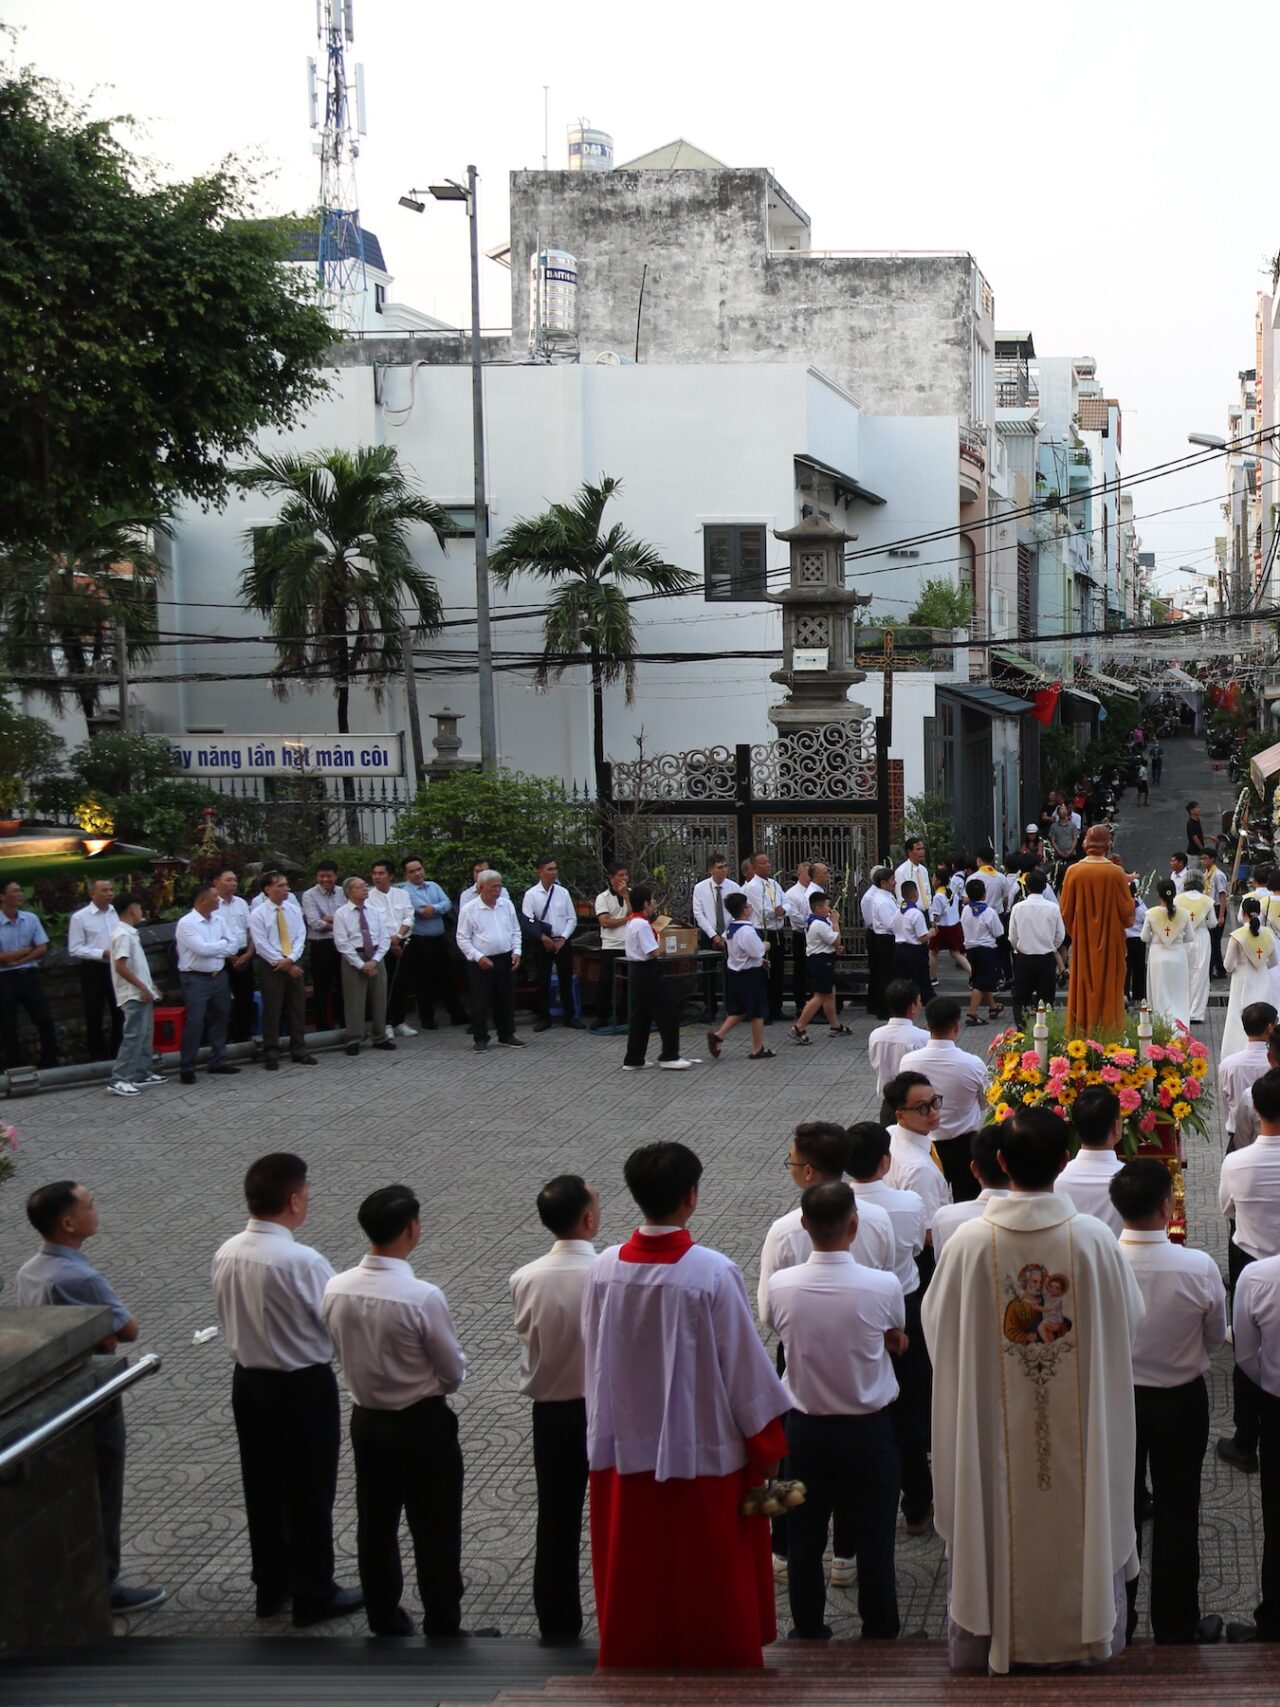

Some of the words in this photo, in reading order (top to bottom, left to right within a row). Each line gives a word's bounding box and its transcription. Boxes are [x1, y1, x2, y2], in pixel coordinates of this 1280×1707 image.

[198, 745, 242, 769] năng
[248, 742, 275, 766] lần
[282, 746, 310, 770] hạt
[316, 744, 355, 766] mân
[360, 744, 388, 766] côi
